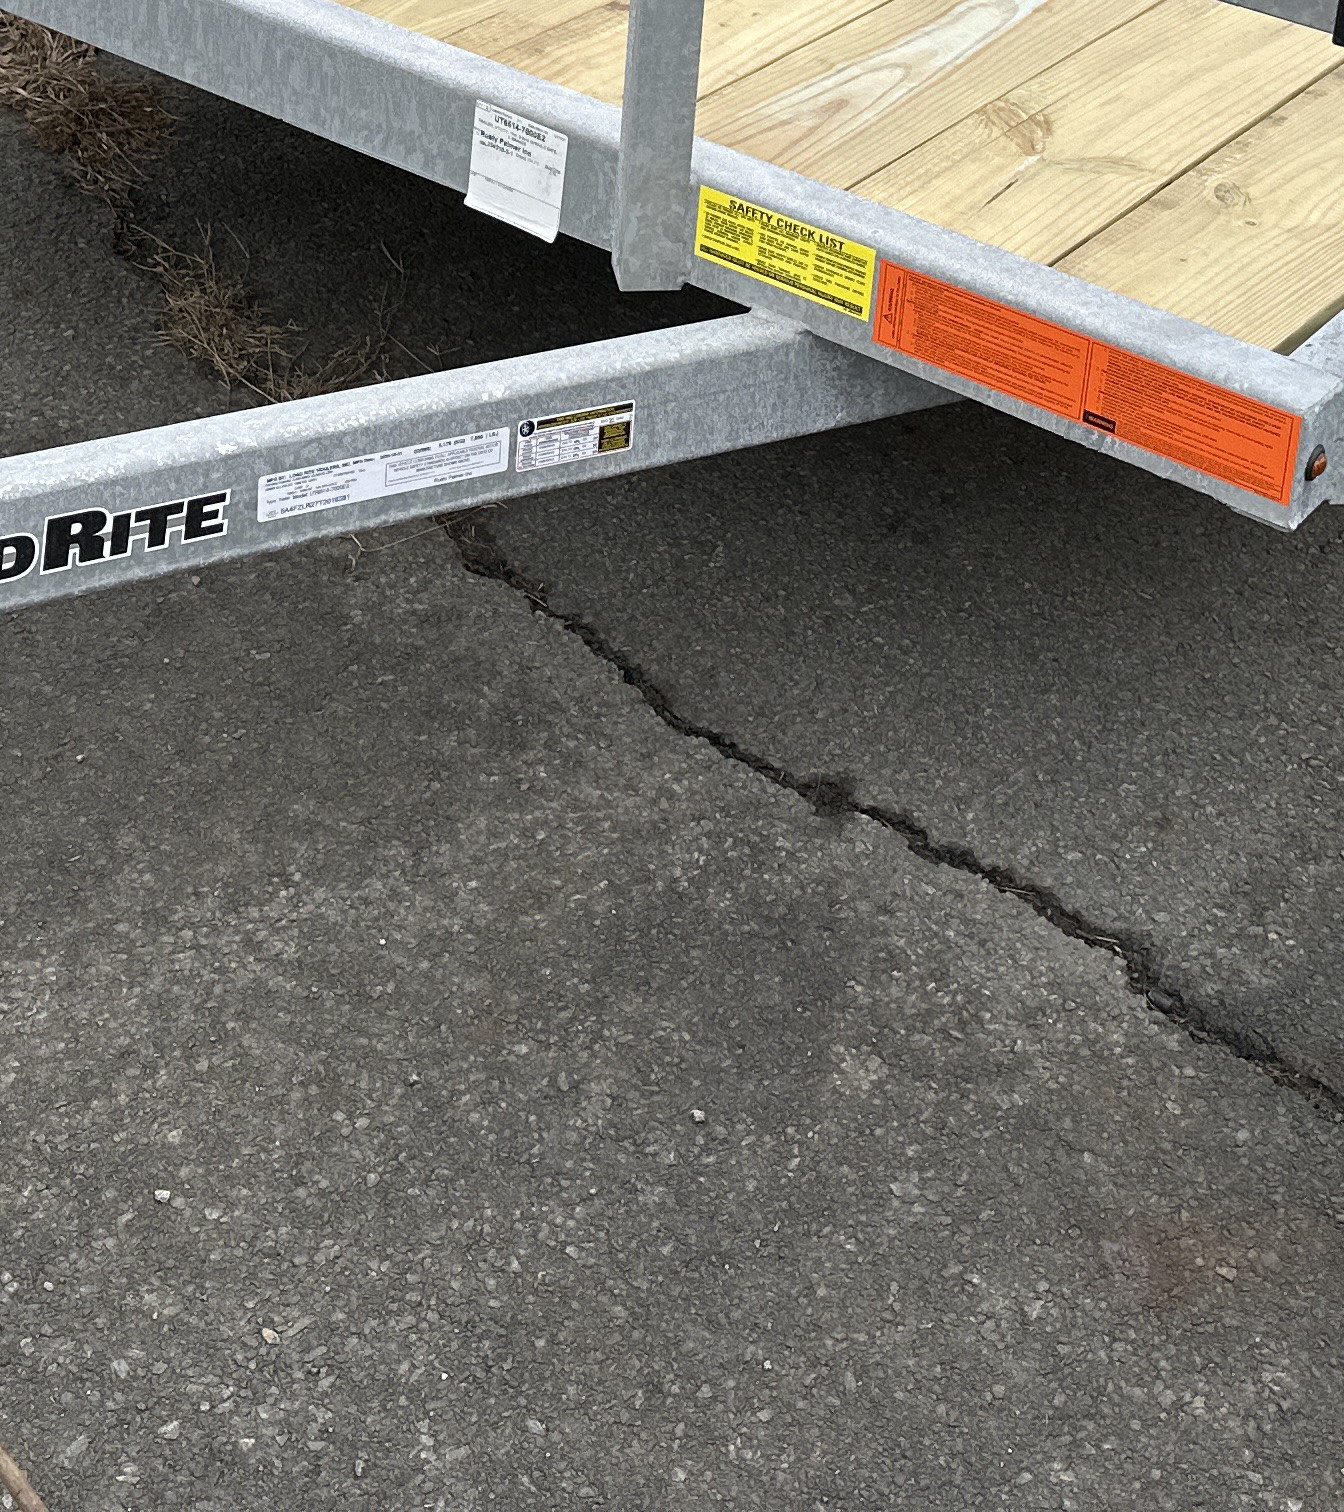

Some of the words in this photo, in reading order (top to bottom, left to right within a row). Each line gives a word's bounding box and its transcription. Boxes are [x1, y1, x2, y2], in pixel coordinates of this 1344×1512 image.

[729, 199, 773, 224] SAFETY
[776, 217, 816, 242] CHECK
[820, 233, 845, 252] LIST
